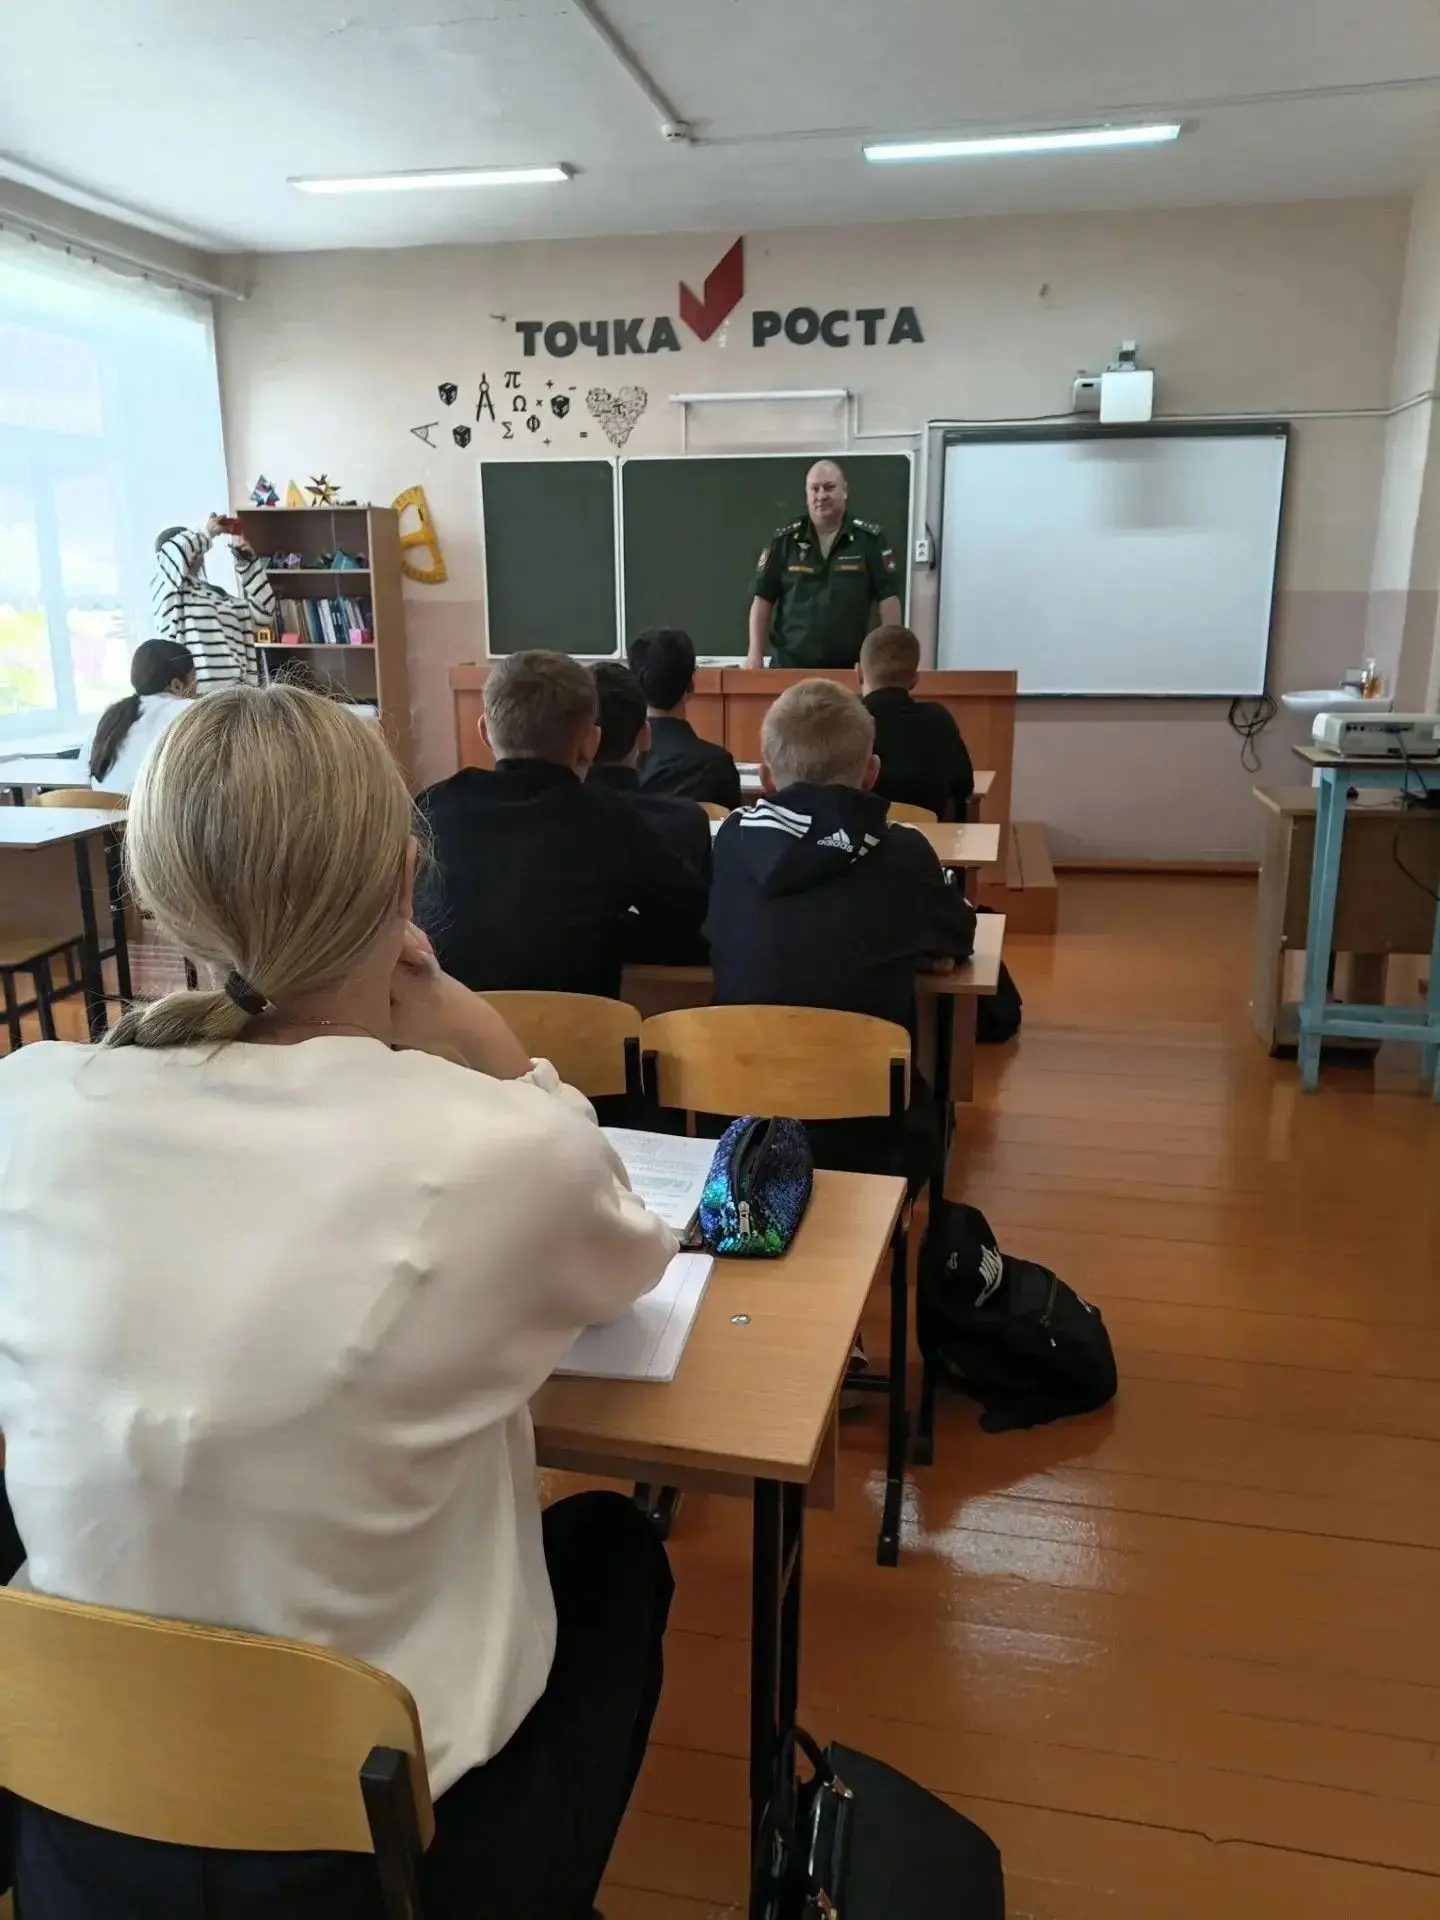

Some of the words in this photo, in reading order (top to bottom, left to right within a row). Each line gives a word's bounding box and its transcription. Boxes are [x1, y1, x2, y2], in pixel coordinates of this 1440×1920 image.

[515, 316, 681, 357] ТОЧКА
[752, 307, 925, 348] РОСТА
[816, 839, 854, 853] adidas
